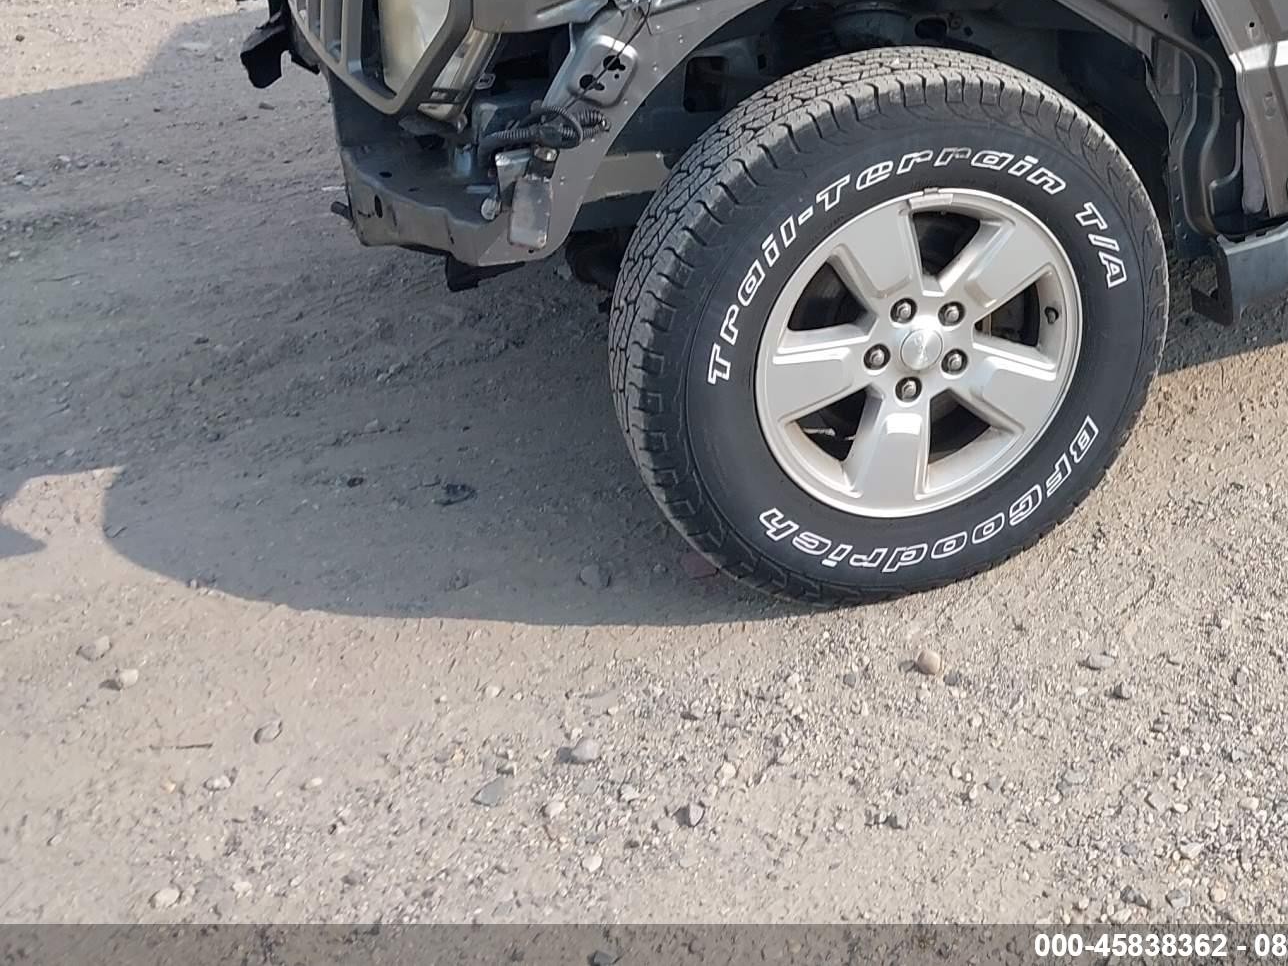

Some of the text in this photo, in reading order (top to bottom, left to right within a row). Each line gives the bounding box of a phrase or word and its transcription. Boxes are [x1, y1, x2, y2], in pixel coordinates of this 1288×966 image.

[708, 146, 1128, 385] Trail-Terrain T/A
[757, 415, 1099, 573] BFGoodrich
